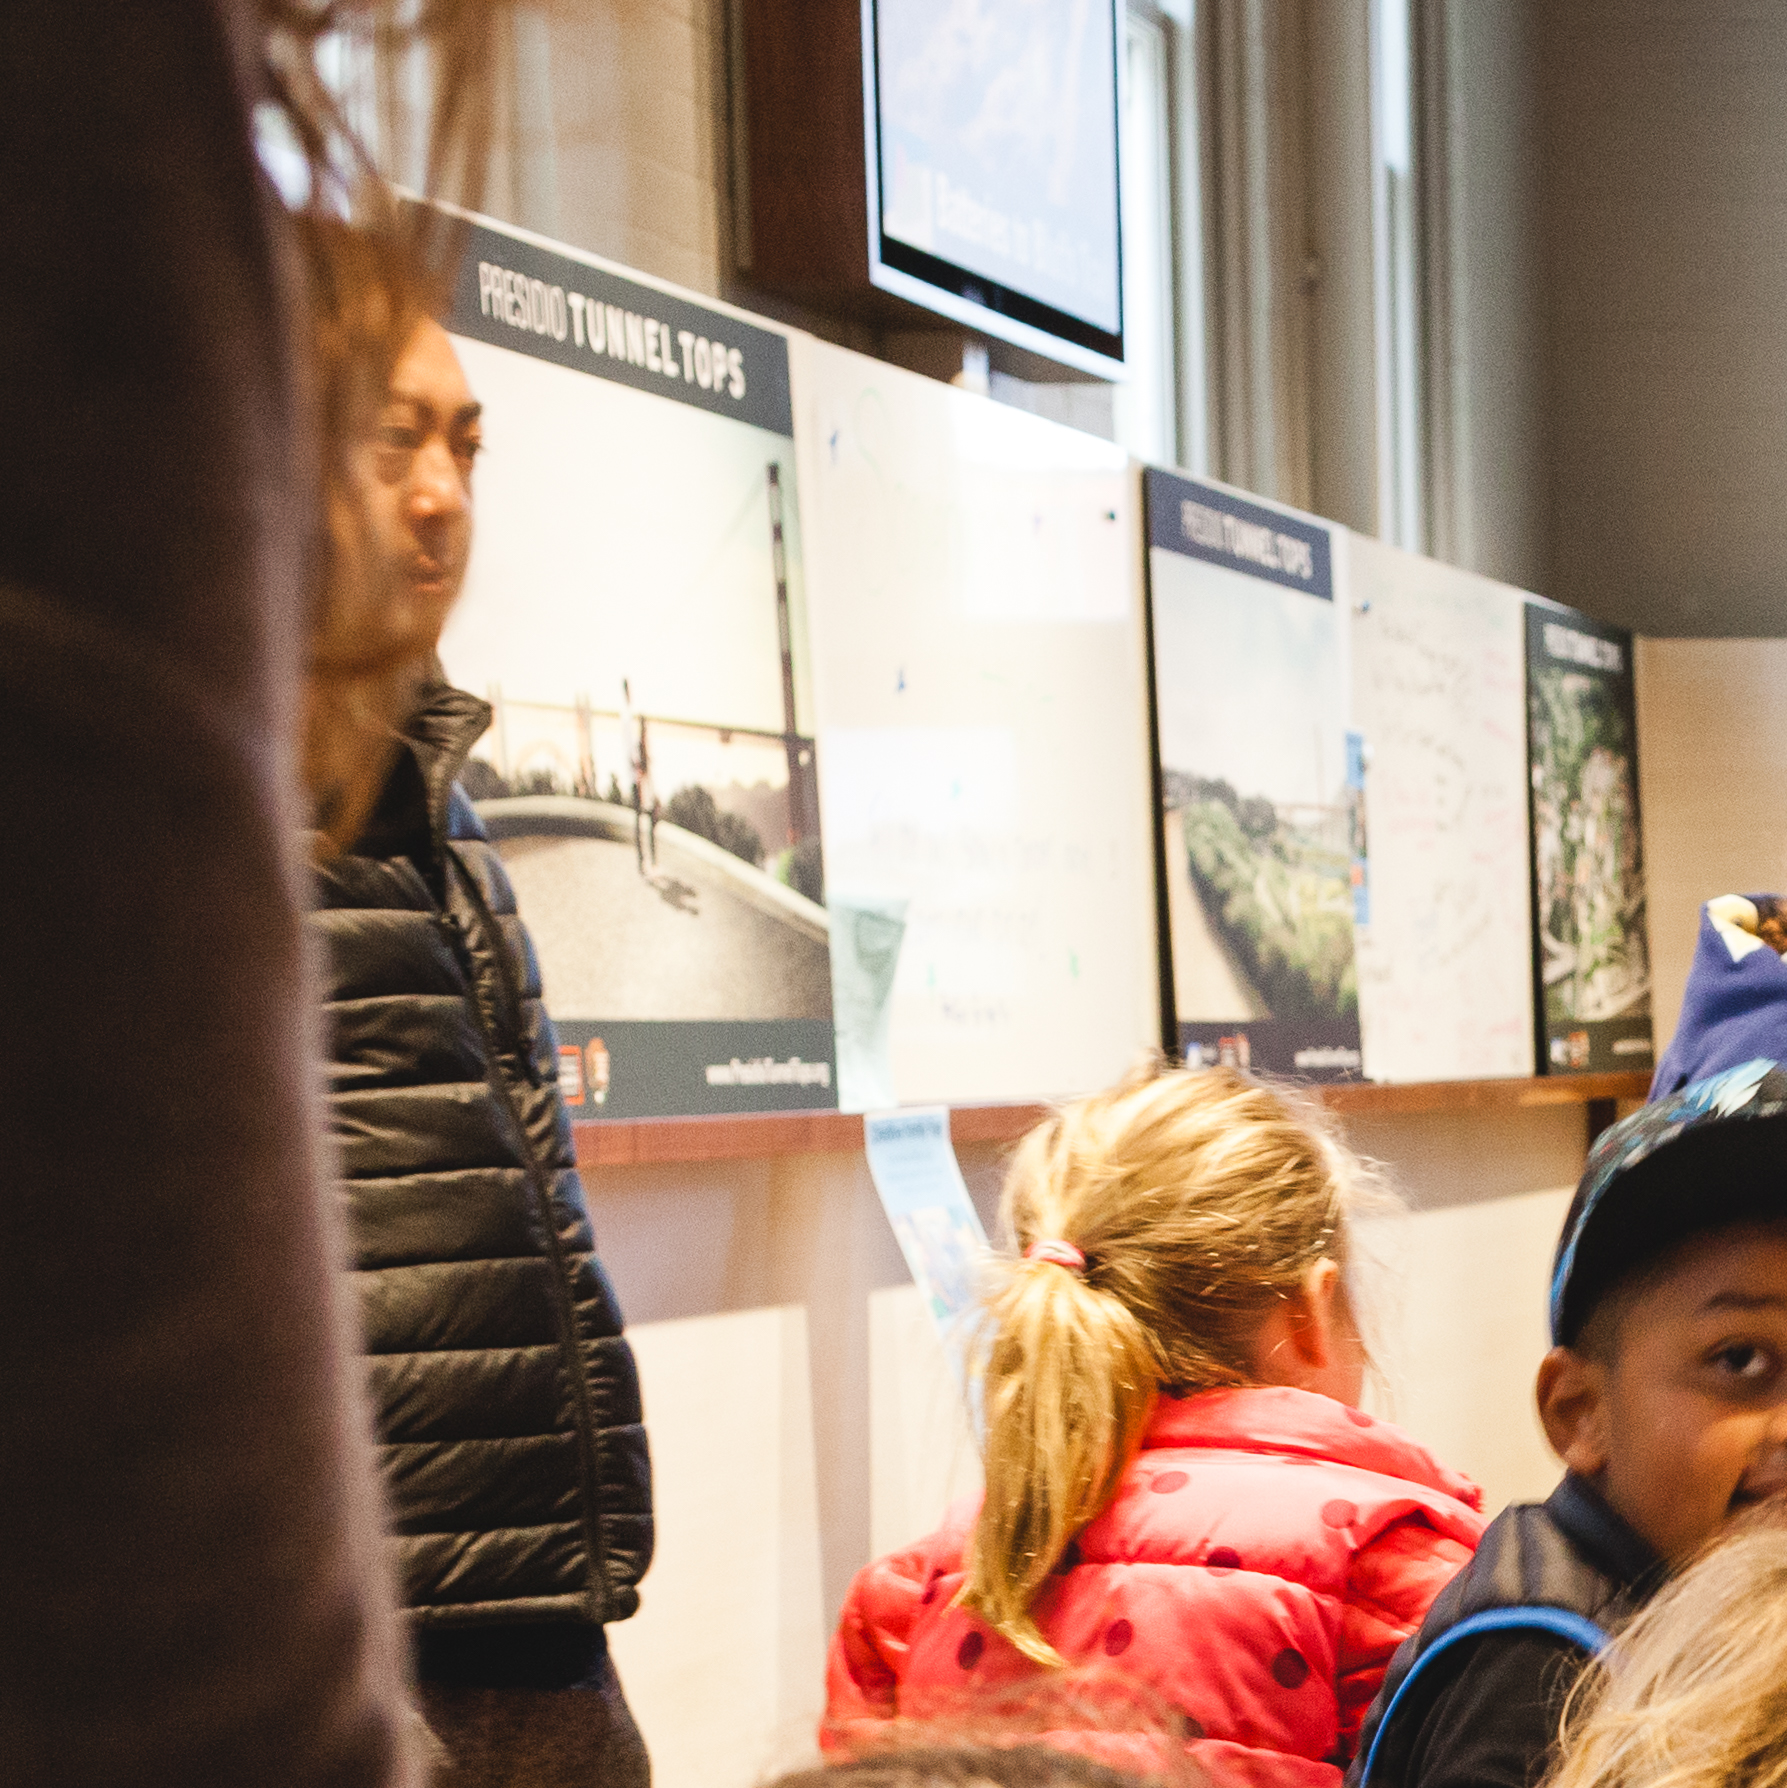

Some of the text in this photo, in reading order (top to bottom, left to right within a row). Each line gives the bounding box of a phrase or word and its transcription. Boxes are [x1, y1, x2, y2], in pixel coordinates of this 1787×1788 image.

[478, 260, 747, 401] PRESIDIO TUNNEL TOPS
